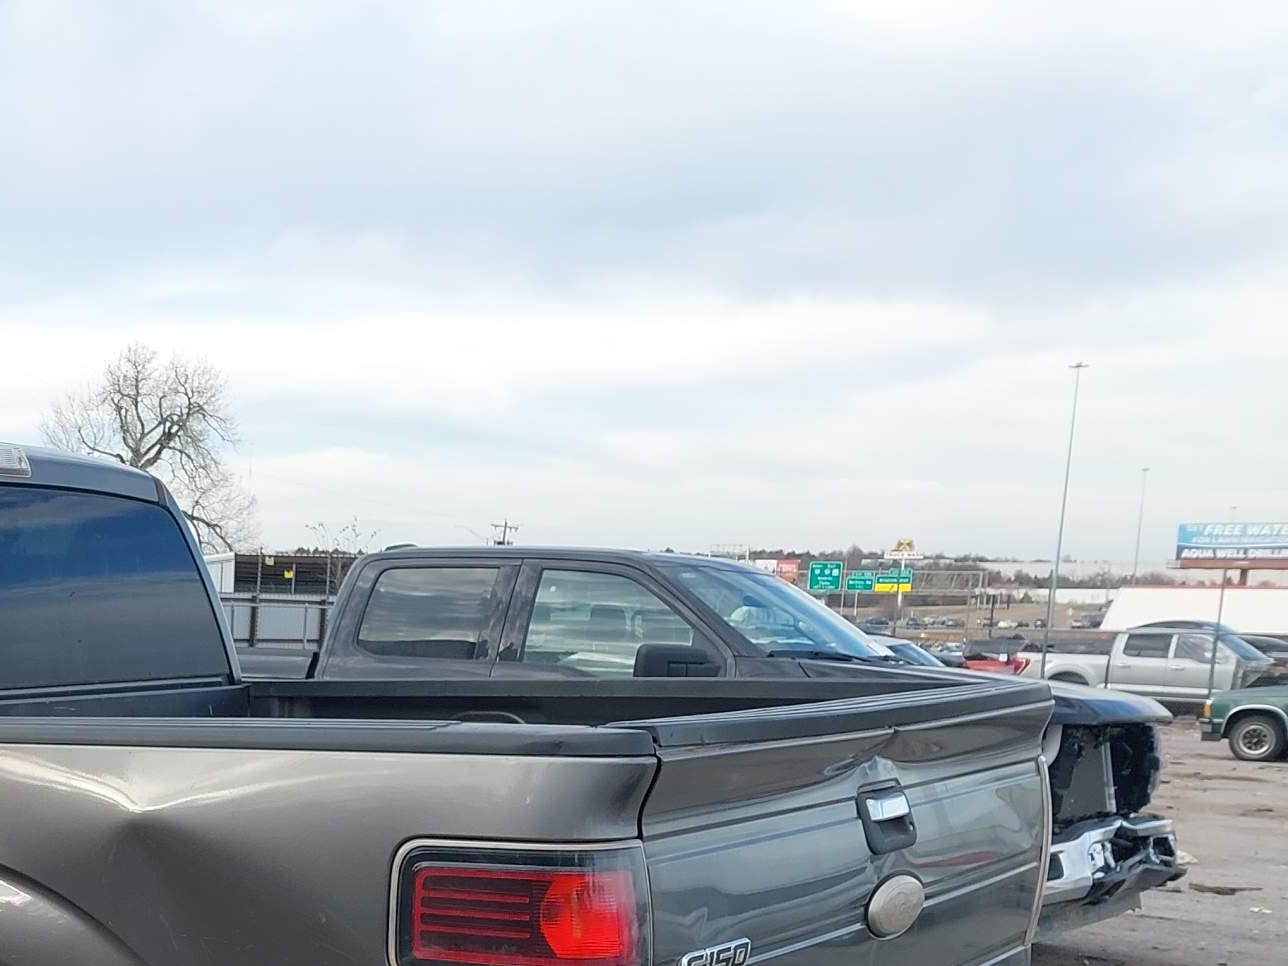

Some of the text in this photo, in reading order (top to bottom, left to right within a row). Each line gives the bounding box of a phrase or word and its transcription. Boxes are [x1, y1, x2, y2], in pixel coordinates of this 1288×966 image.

[1204, 524, 1245, 536] FREE
[1181, 549, 1215, 559] AQUA
[1216, 549, 1246, 559] WELL
